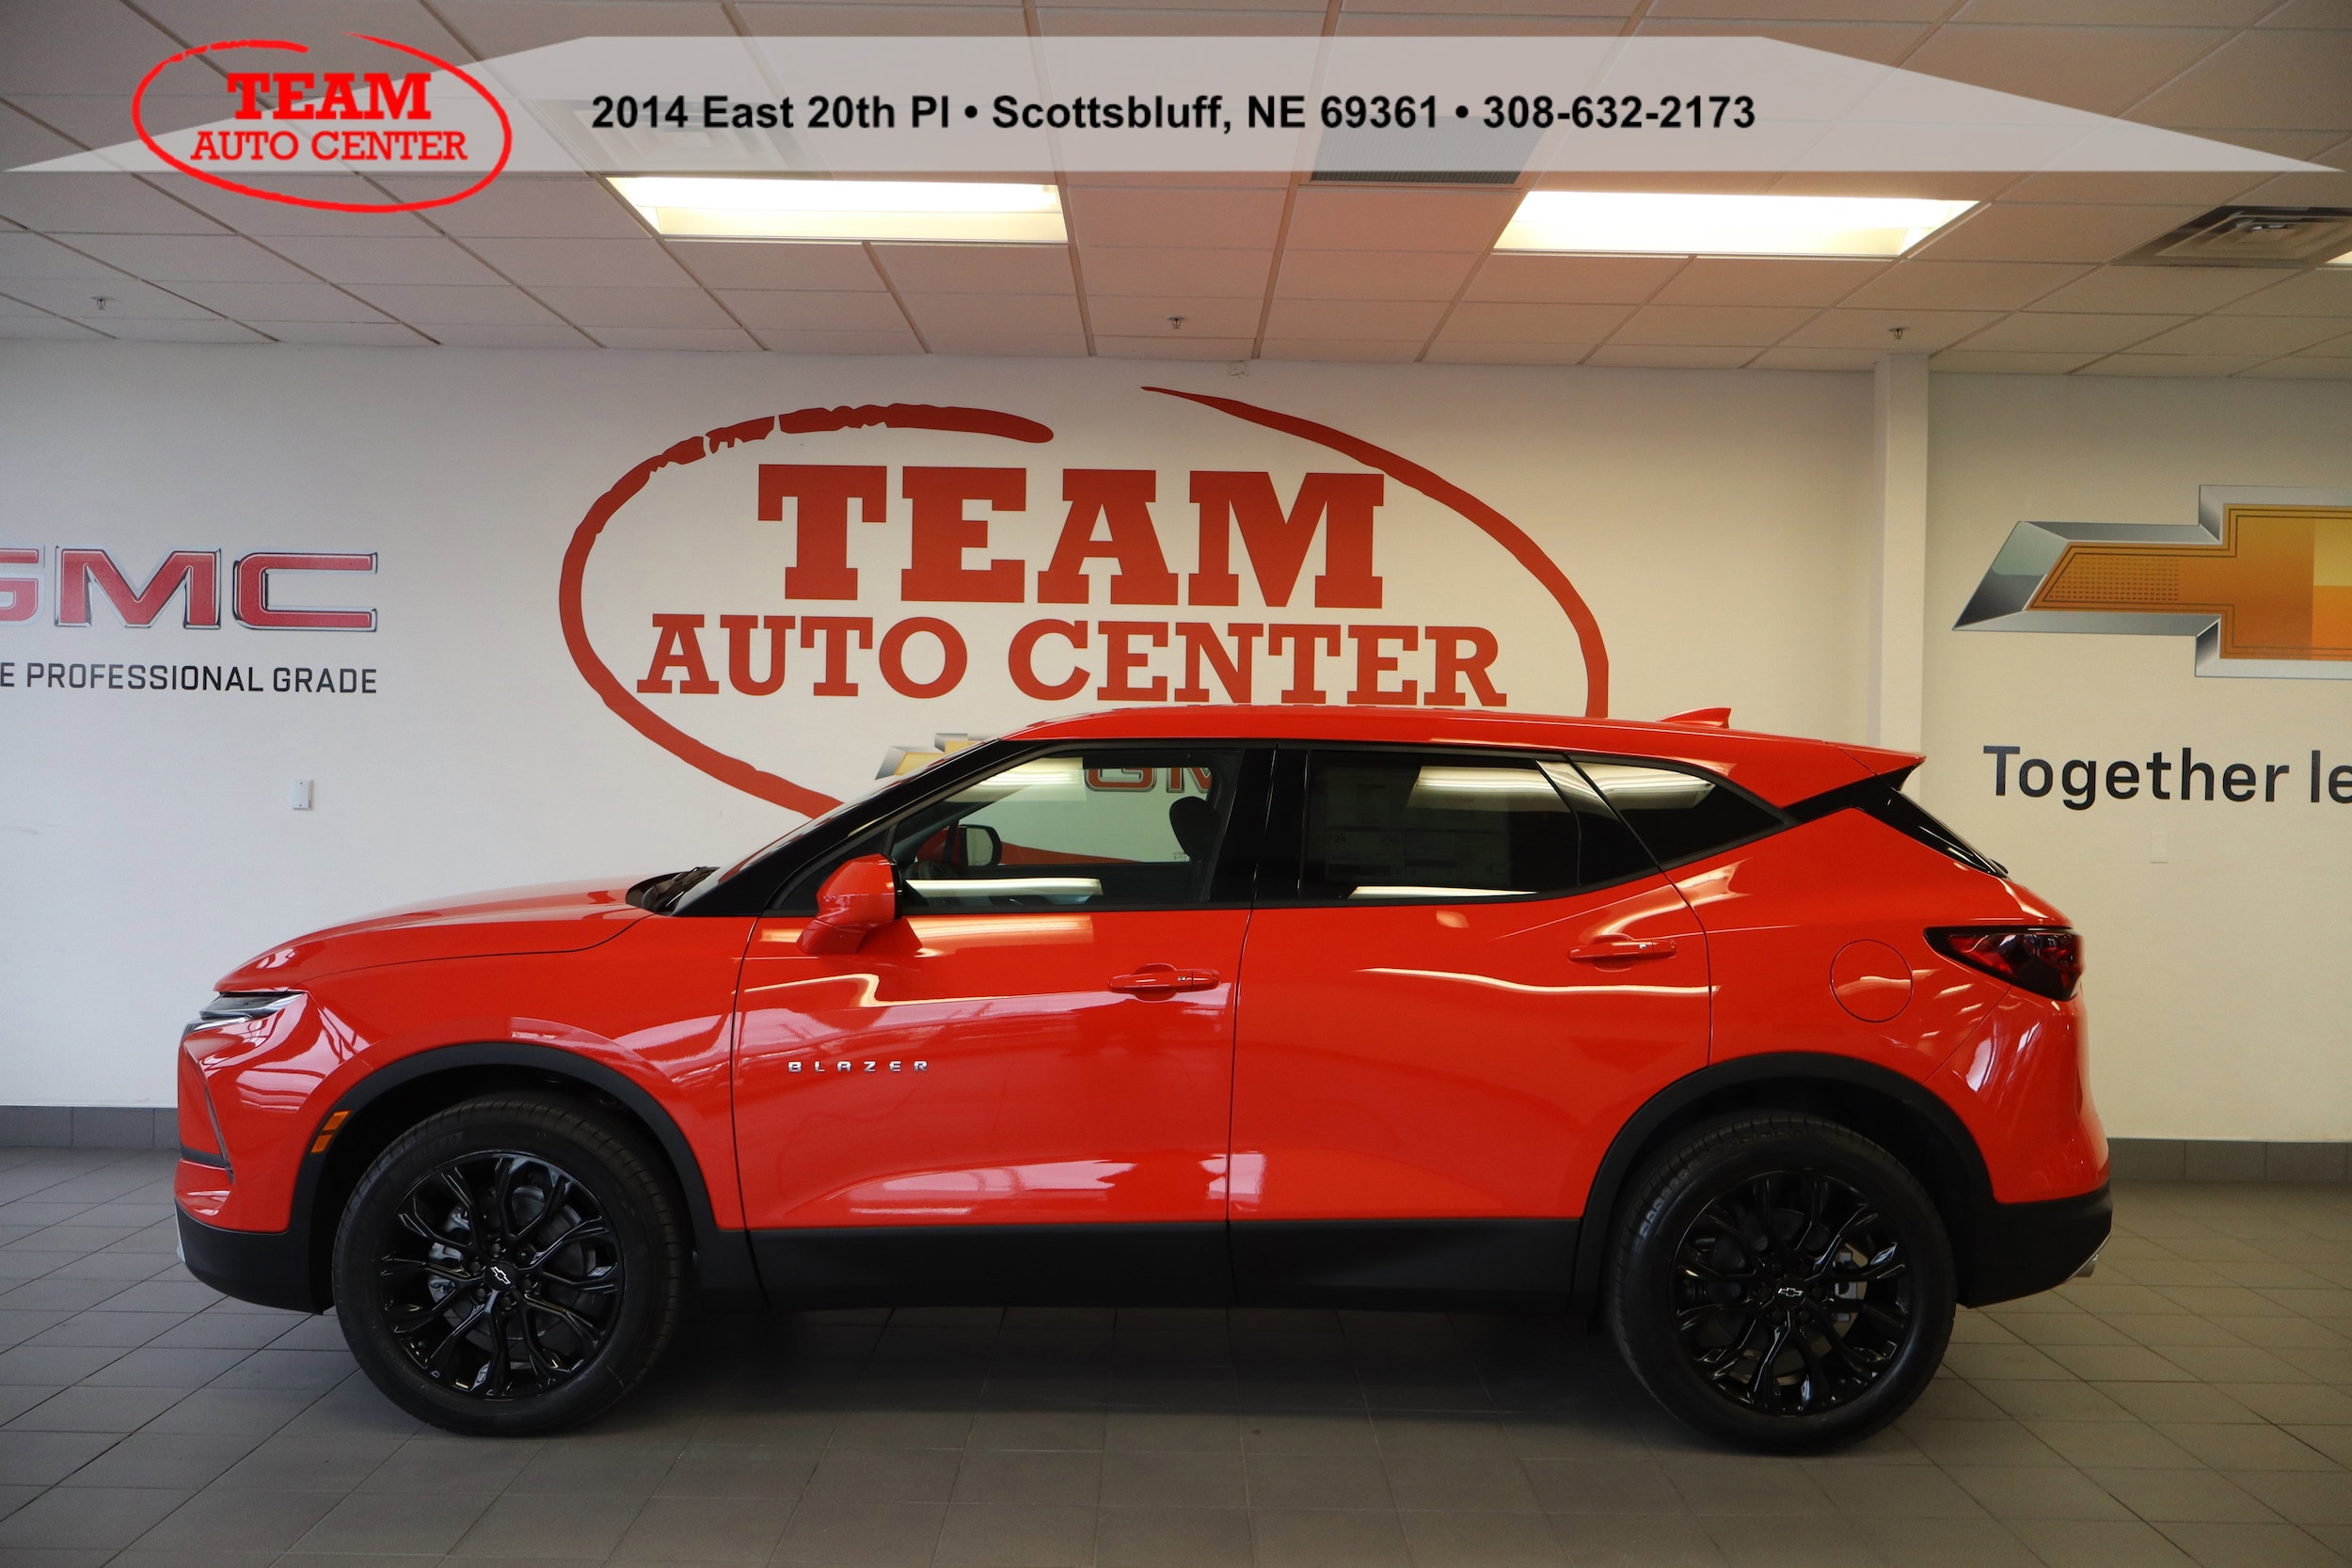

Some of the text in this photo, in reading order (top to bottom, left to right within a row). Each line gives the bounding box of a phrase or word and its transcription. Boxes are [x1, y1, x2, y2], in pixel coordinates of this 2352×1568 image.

[758, 464, 1385, 610] TEAM
[26, 662, 264, 692] PROFESSIONAL
[273, 667, 377, 694] GRADE
[636, 613, 1507, 707] AUTO CENTER
[1983, 745, 2290, 811] Together
[787, 1061, 929, 1073] BLAZER
